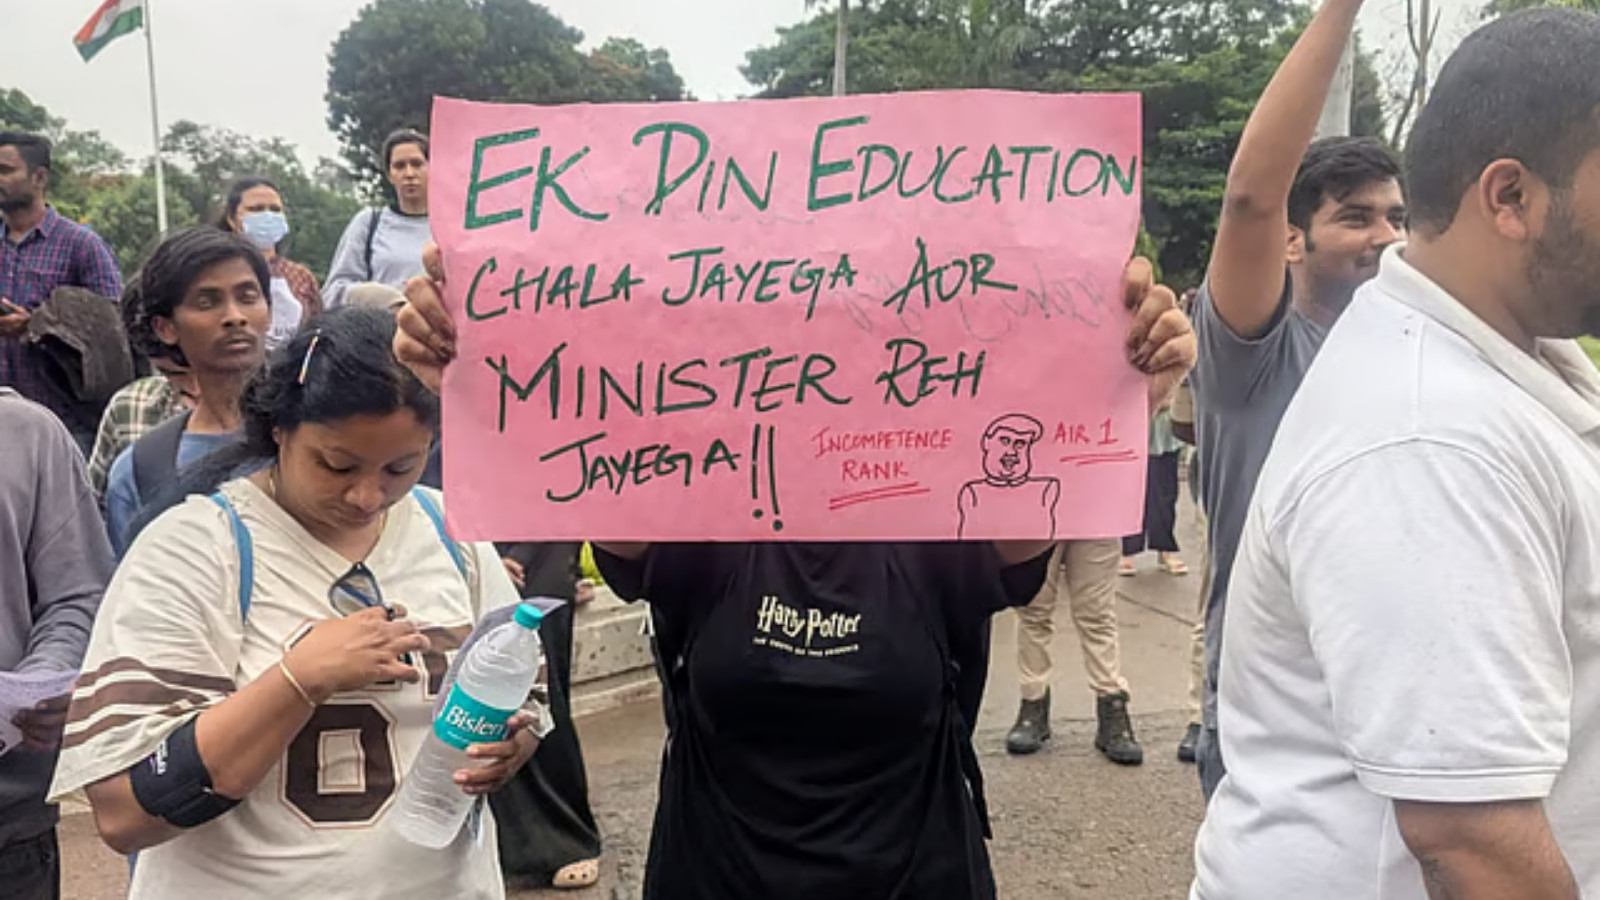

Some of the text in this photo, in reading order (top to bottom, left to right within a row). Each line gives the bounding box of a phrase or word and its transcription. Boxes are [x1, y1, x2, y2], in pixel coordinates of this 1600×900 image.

[464, 127, 609, 232] EK
[632, 122, 778, 216] DIN
[807, 115, 1137, 212] EDUCATION
[466, 257, 644, 320] CHALA
[662, 247, 857, 319] JAYEGA
[883, 236, 1018, 314] AOR
[486, 338, 985, 434] MINISTER REH
[811, 426, 953, 459] INCOMPETENCE
[1052, 418, 1119, 446] AIR 1
[842, 459, 908, 481] RANK
[757, 596, 805, 637] Harry
[805, 608, 861, 647] Potter
